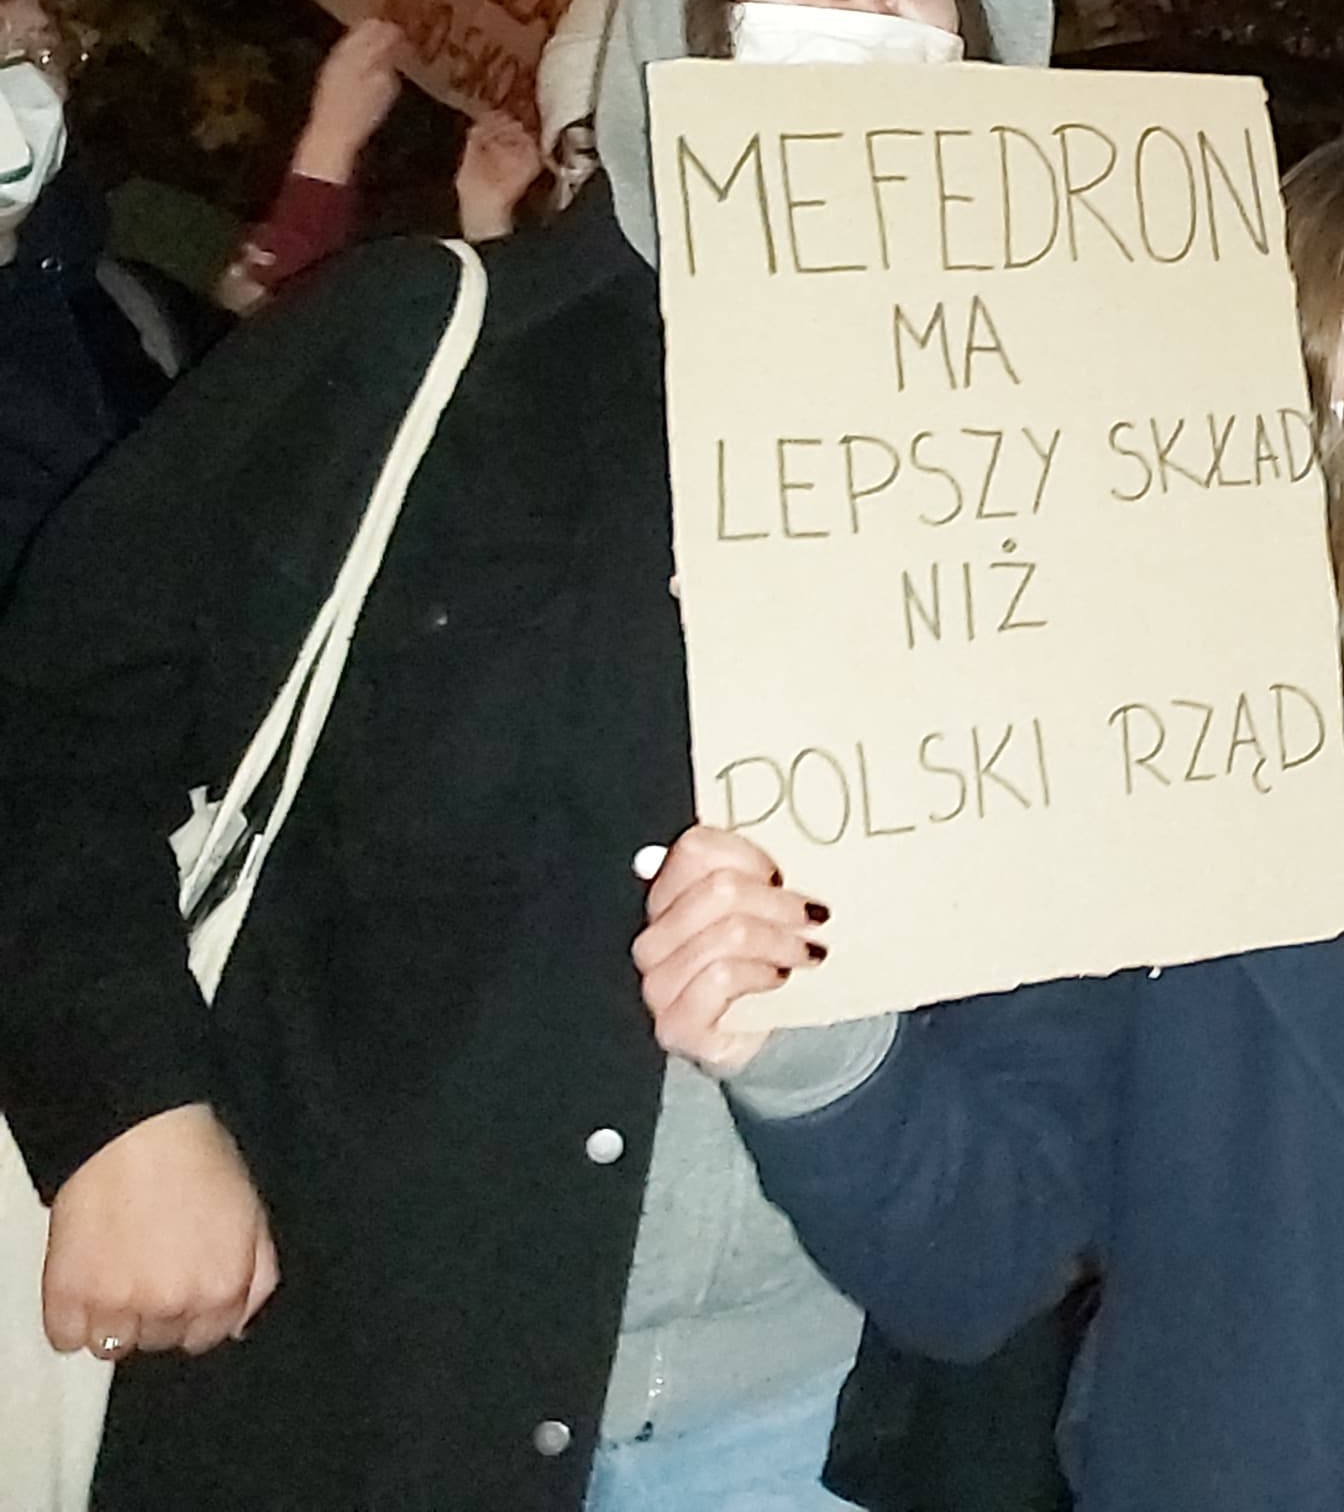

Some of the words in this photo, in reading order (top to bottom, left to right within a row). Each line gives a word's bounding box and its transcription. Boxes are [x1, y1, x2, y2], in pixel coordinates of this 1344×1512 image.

[677, 123, 1270, 276] MEFEDRON
[892, 294, 1021, 392] MA
[715, 426, 1062, 542] LEPSZY
[1107, 406, 1321, 502] SKŁAD
[901, 538, 1049, 650] NIŻ
[715, 716, 1051, 846] POLSKI
[1107, 683, 1328, 796] RZĄD
